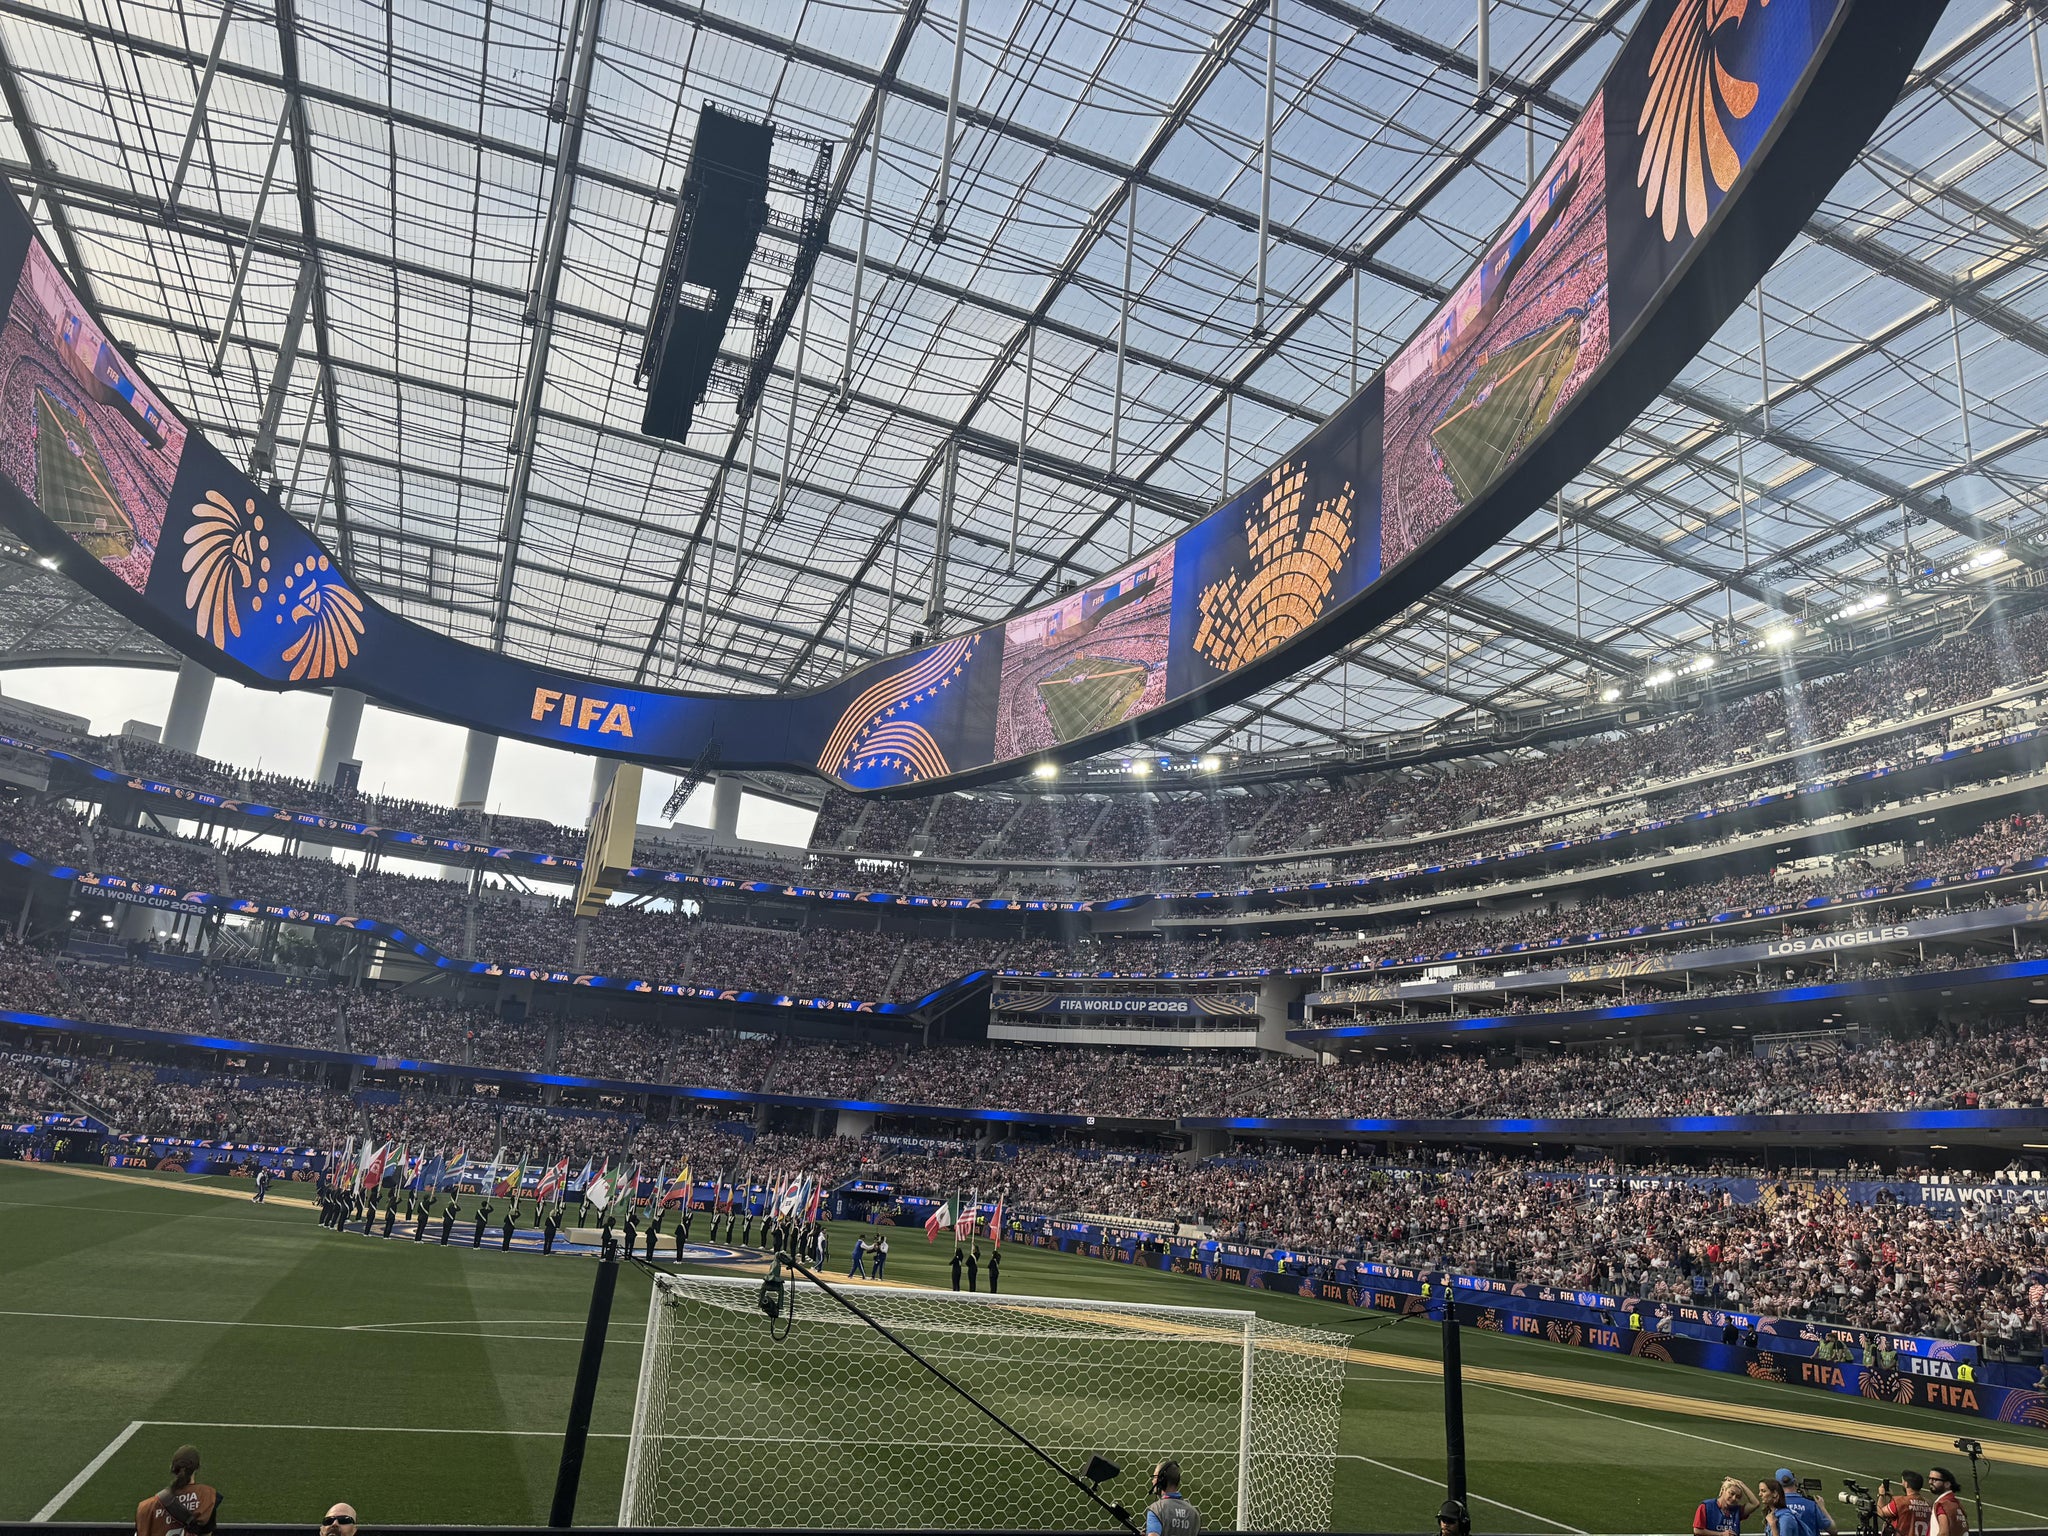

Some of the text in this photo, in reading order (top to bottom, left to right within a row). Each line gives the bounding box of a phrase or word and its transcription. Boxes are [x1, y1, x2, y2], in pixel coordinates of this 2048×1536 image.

[154, 784, 171, 794] FIFA
[199, 795, 215, 804] FIFA
[298, 815, 314, 824] FIFA
[340, 823, 357, 831] FIFA
[434, 839, 449, 848] FIFA
[474, 846, 489, 854] FIFA
[108, 878, 127, 888] FIFA
[159, 888, 177, 897] FIFA
[81, 885, 207, 915] FIFA WORLD CUP 2026
[266, 906, 284, 915] FIFA
[313, 914, 330, 922] FIFA
[1768, 926, 1909, 956] LOS ANGELES
[510, 968, 526, 977] FIFA
[552, 973, 569, 982] FIFA
[1060, 1000, 1188, 1012] FIFA WORLD CUP 2026
[122, 1157, 147, 1168] FIFA
[1922, 1188, 1956, 1202] FIFA
[1118, 1251, 1129, 1261] FIFA
[1226, 1268, 1241, 1281] FIFA
[1402, 1270, 1413, 1278] FIFA
[1459, 1277, 1471, 1286] FIFA
[1322, 1285, 1342, 1299] FIFA
[1493, 1282, 1506, 1292] FIFA
[1374, 1293, 1396, 1309] FIFA
[1560, 1292, 1575, 1302] FIFA
[1600, 1297, 1616, 1307] FIFA
[1680, 1308, 1698, 1319] FIFA
[1512, 1316, 1540, 1334] FIFA
[1589, 1328, 1620, 1348] FIFA
[1893, 1338, 1918, 1353] FIFA
[1912, 1358, 1953, 1379] FIFA
[1802, 1363, 1845, 1387] FIFA
[1926, 1383, 1979, 1411] FIFA
[1175, 1508, 1186, 1518] HB
[1172, 1518, 1190, 1529] 0310
